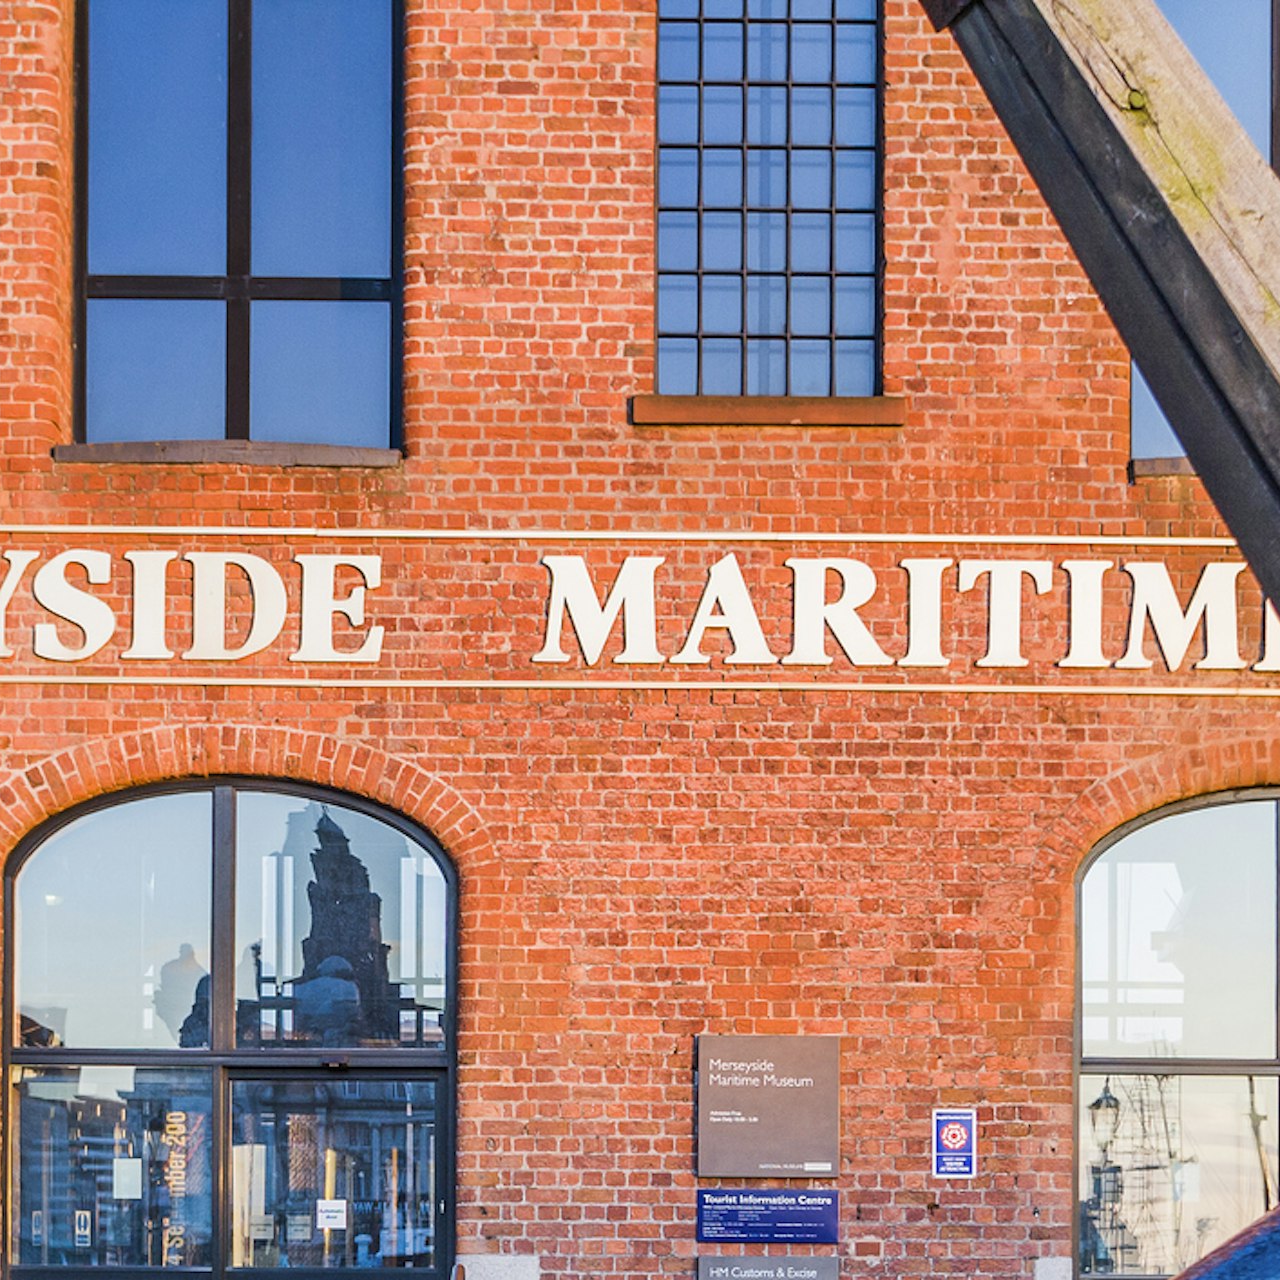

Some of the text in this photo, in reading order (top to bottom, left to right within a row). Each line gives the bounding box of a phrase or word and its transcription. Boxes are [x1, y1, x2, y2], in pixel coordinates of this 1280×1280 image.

[708, 1058, 775, 1074] Merseyside
[708, 1073, 814, 1087] Maritime Museum
[703, 1193, 832, 1206] Tourist Information Centre
[709, 1266, 818, 1279] HM Customs & Excise
